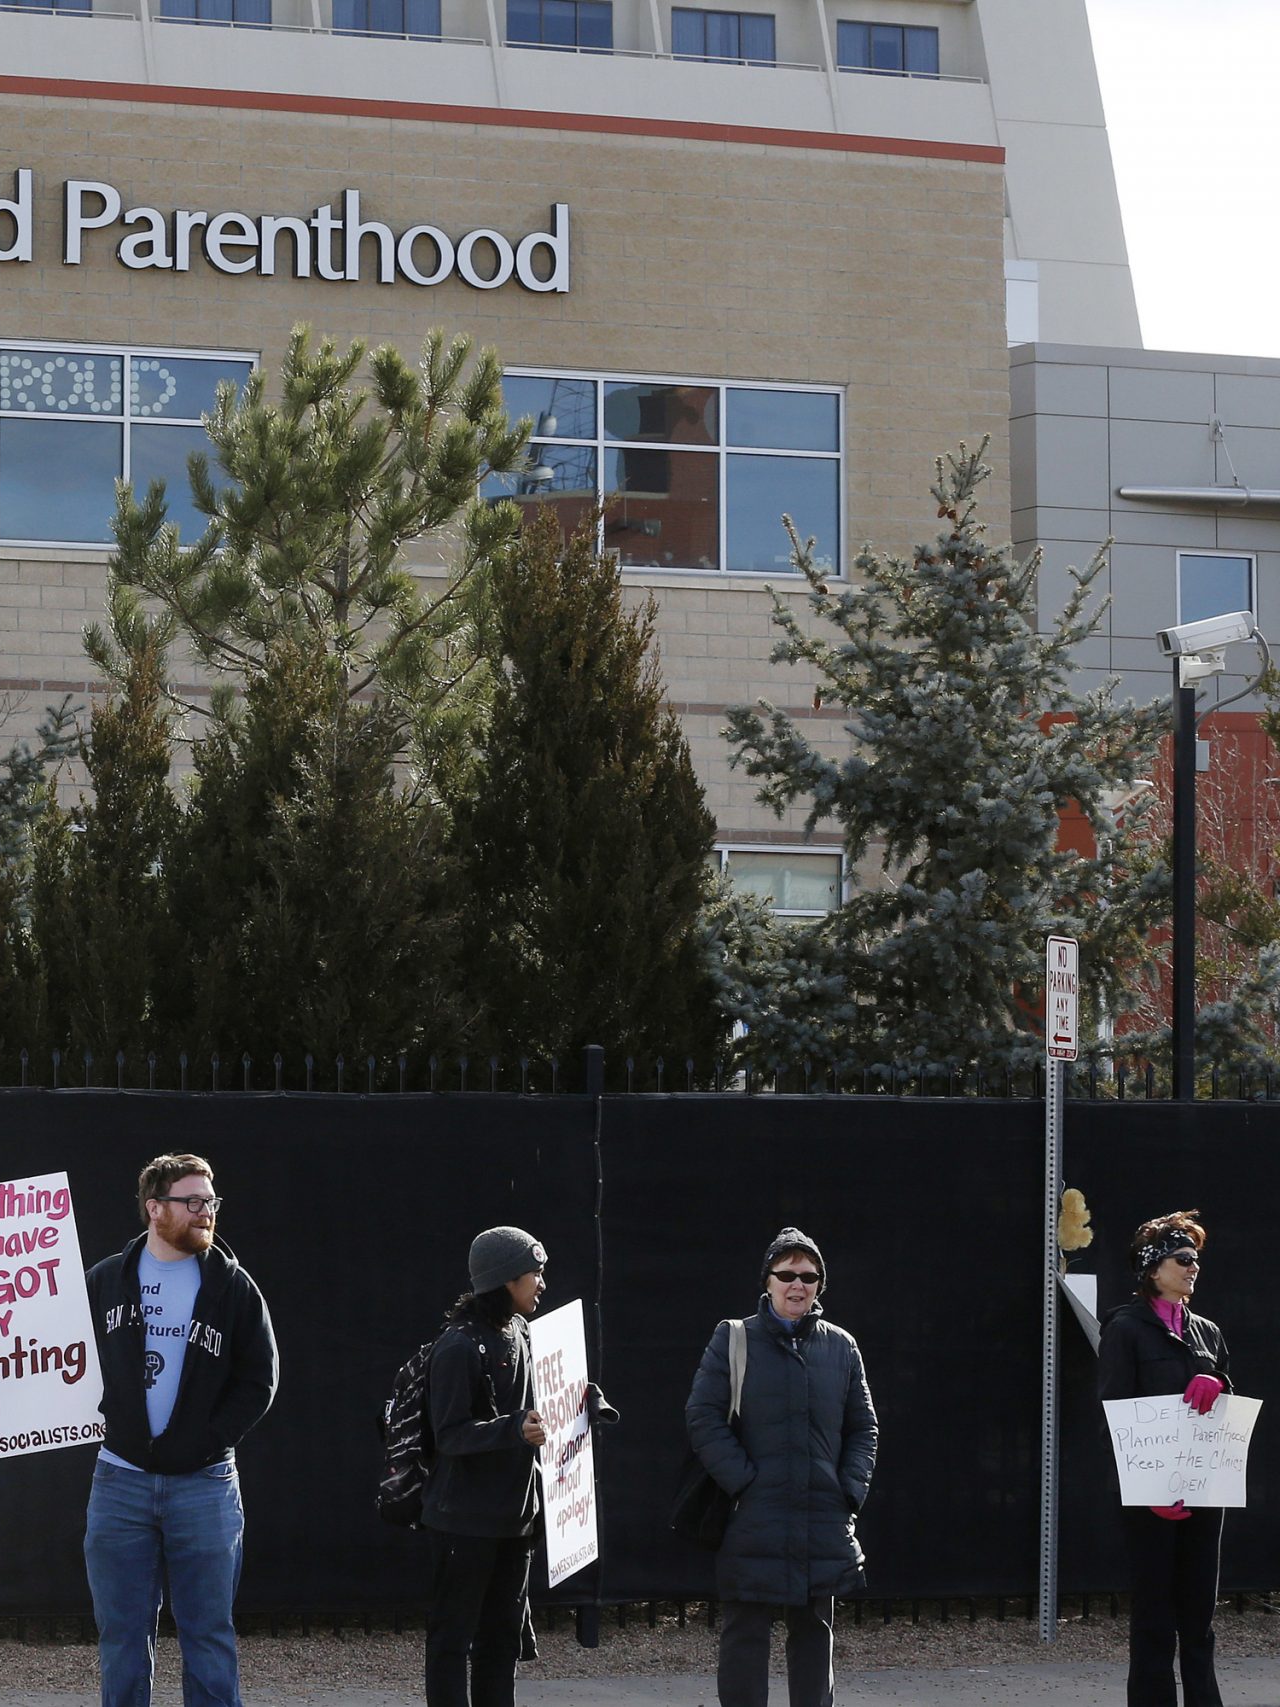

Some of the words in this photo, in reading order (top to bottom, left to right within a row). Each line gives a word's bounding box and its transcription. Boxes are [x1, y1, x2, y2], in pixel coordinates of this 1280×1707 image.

[62, 178, 570, 294] Parenthood
[1058, 946, 1067, 968] NO
[1050, 970, 1075, 994] PARKING
[1056, 997, 1068, 1012] ANY
[1056, 1015, 1069, 1031] TIME
[106, 1304, 124, 1334] SAN
[145, 1322, 186, 1337] lture!
[536, 1348, 565, 1399] FREE
